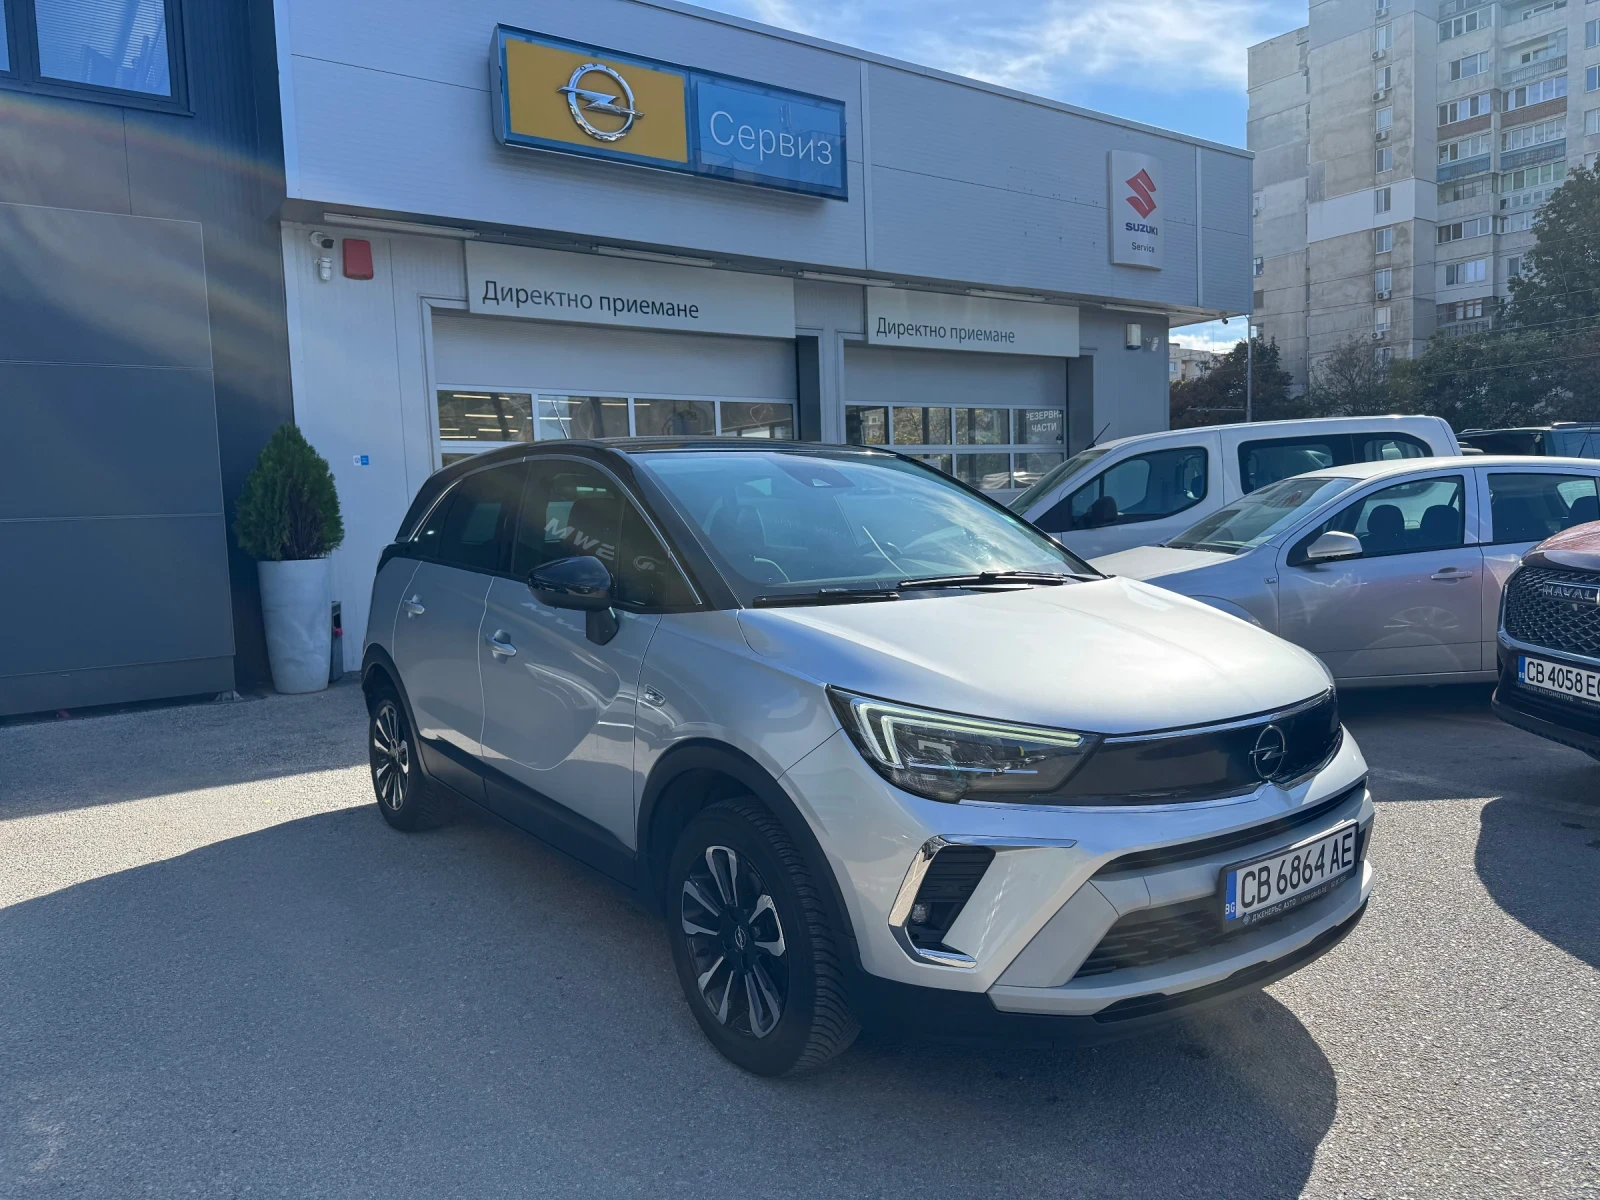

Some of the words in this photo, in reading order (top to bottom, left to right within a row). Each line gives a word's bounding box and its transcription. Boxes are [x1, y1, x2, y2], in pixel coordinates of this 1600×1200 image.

[710, 110, 833, 165] Сервиз
[1125, 222, 1158, 236] SUZUKI
[1131, 241, 1155, 253] Service
[482, 280, 593, 309] Директно
[599, 295, 699, 319] приемане
[876, 317, 947, 339] Директно
[950, 327, 1015, 344] приемане
[1031, 422, 1057, 432] ЧАСТИ
[1543, 584, 1596, 601] HAVAL
[1527, 660, 1545, 684] CB
[1548, 666, 1583, 694] 4058
[1225, 902, 1236, 914] BG
[1240, 865, 1272, 909] CB
[1276, 843, 1325, 895] 6864
[1329, 832, 1353, 874] AE
